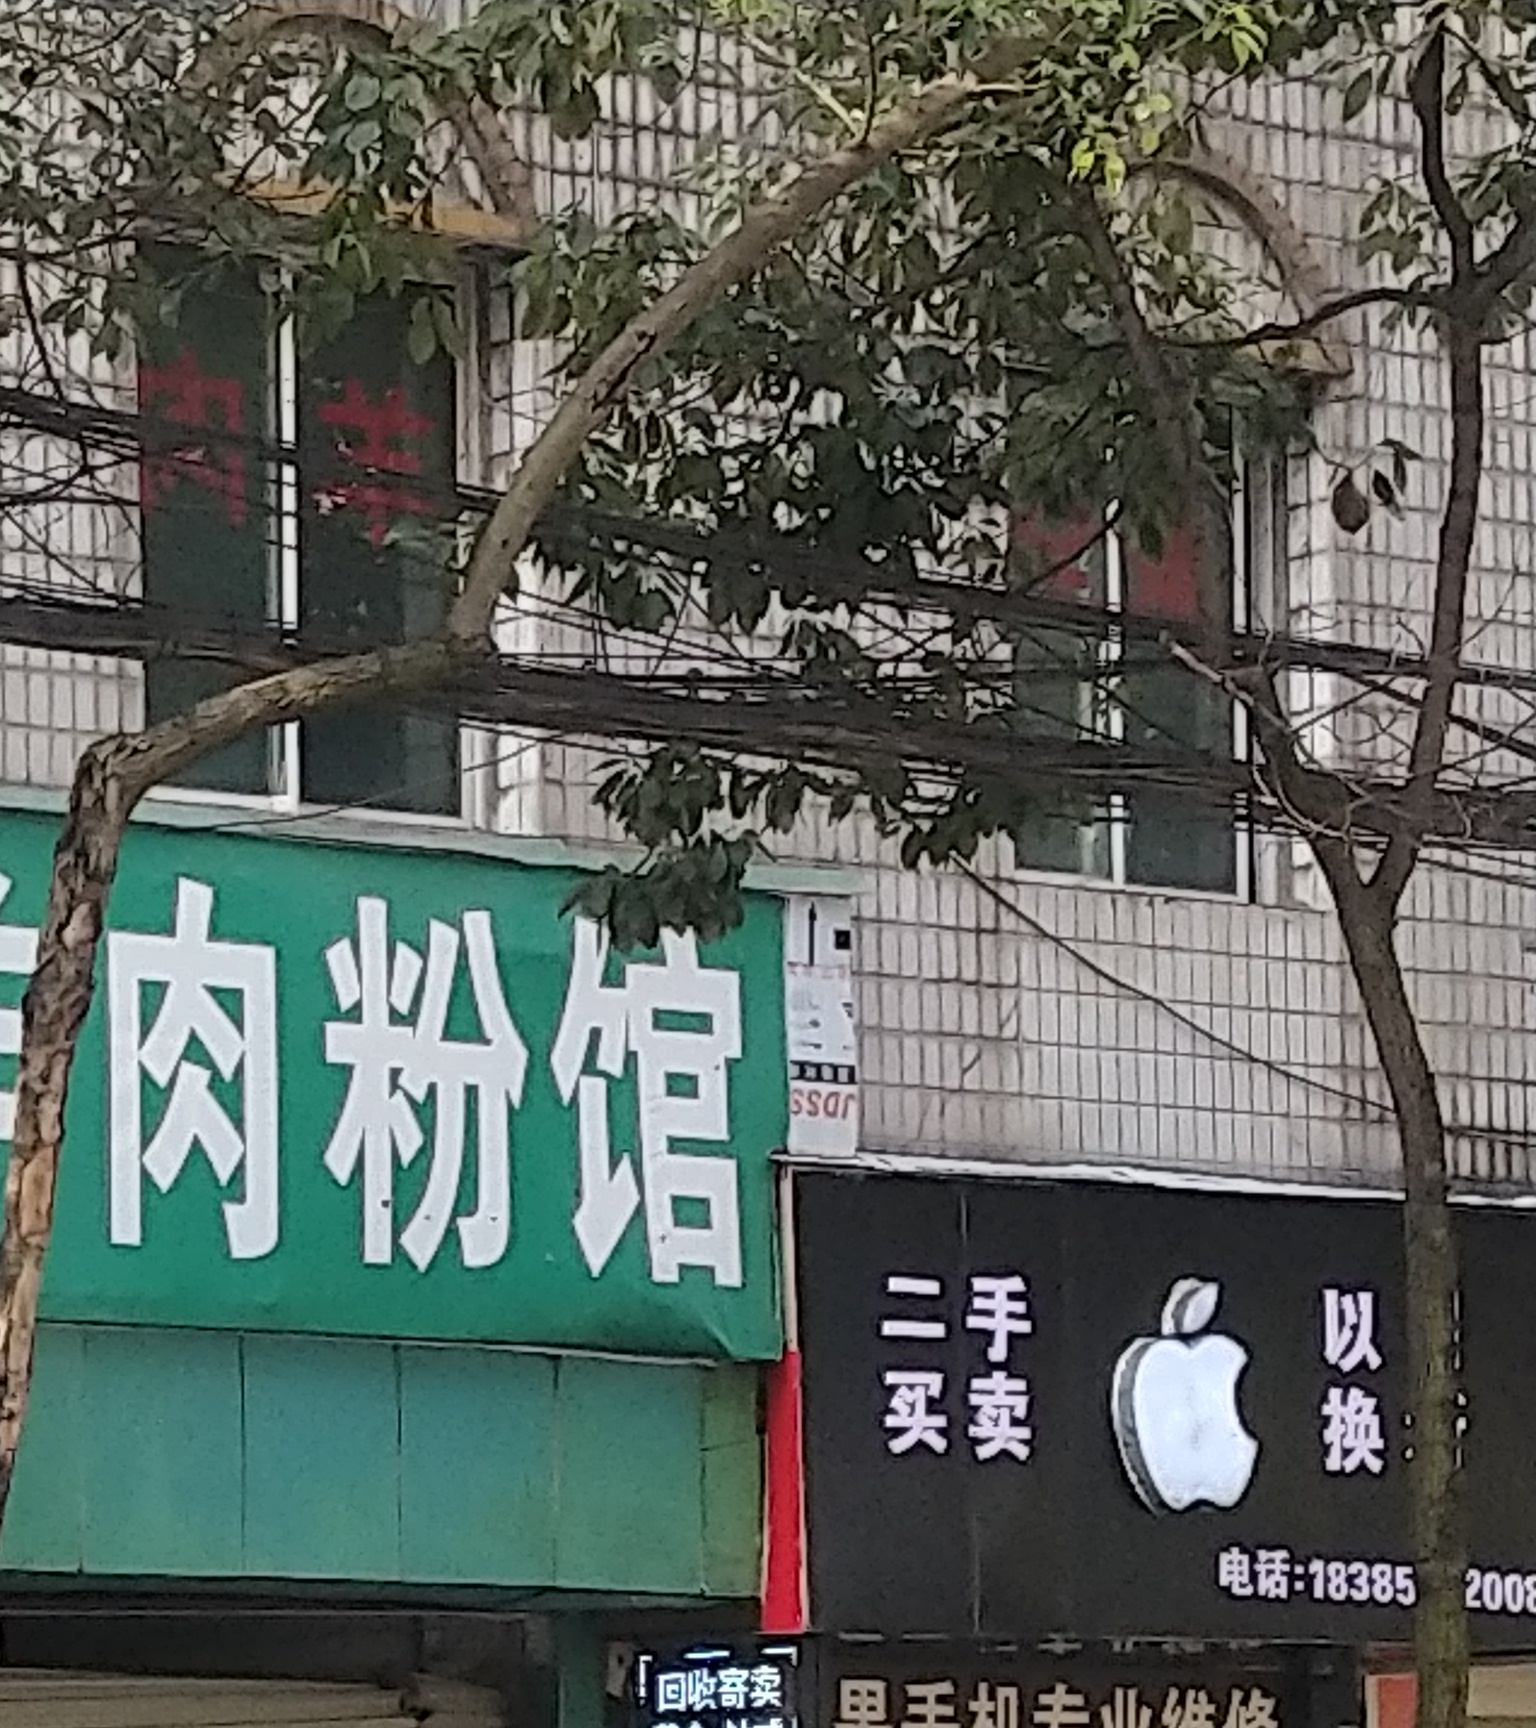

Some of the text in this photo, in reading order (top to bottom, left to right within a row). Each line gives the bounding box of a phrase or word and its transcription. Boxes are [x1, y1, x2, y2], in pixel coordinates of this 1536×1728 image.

[880, 1273, 1033, 1364] 二手
[881, 1371, 1033, 1463] 买卖
[656, 1665, 784, 1713] 回收寄卖
